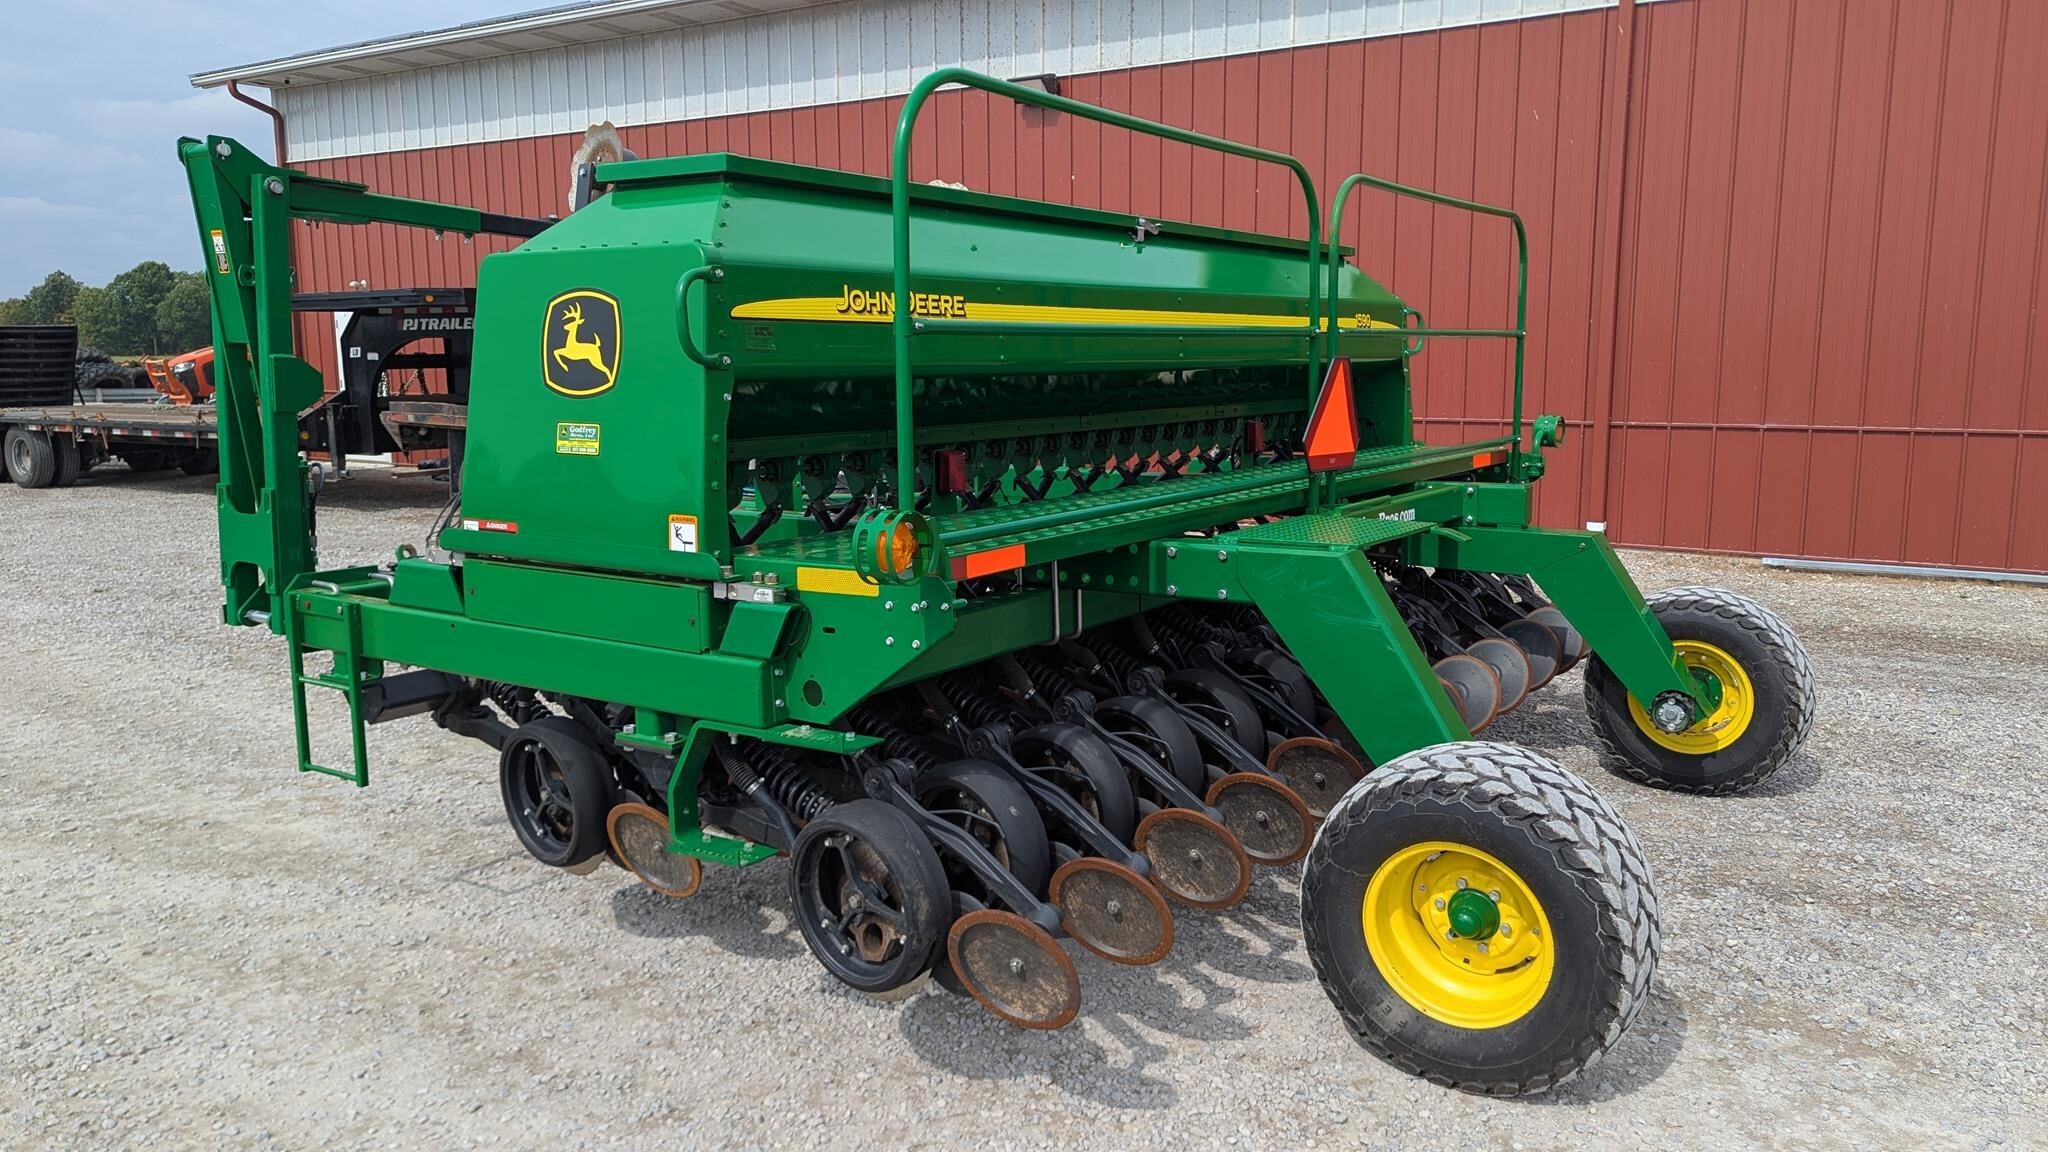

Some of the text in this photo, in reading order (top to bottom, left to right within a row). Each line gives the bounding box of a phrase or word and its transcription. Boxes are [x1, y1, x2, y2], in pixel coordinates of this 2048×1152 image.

[836, 284, 896, 314] JOHN
[402, 317, 475, 331] PJ TRAILE
[1355, 313, 1371, 328] 1590
[569, 425, 596, 436] Godfrey
